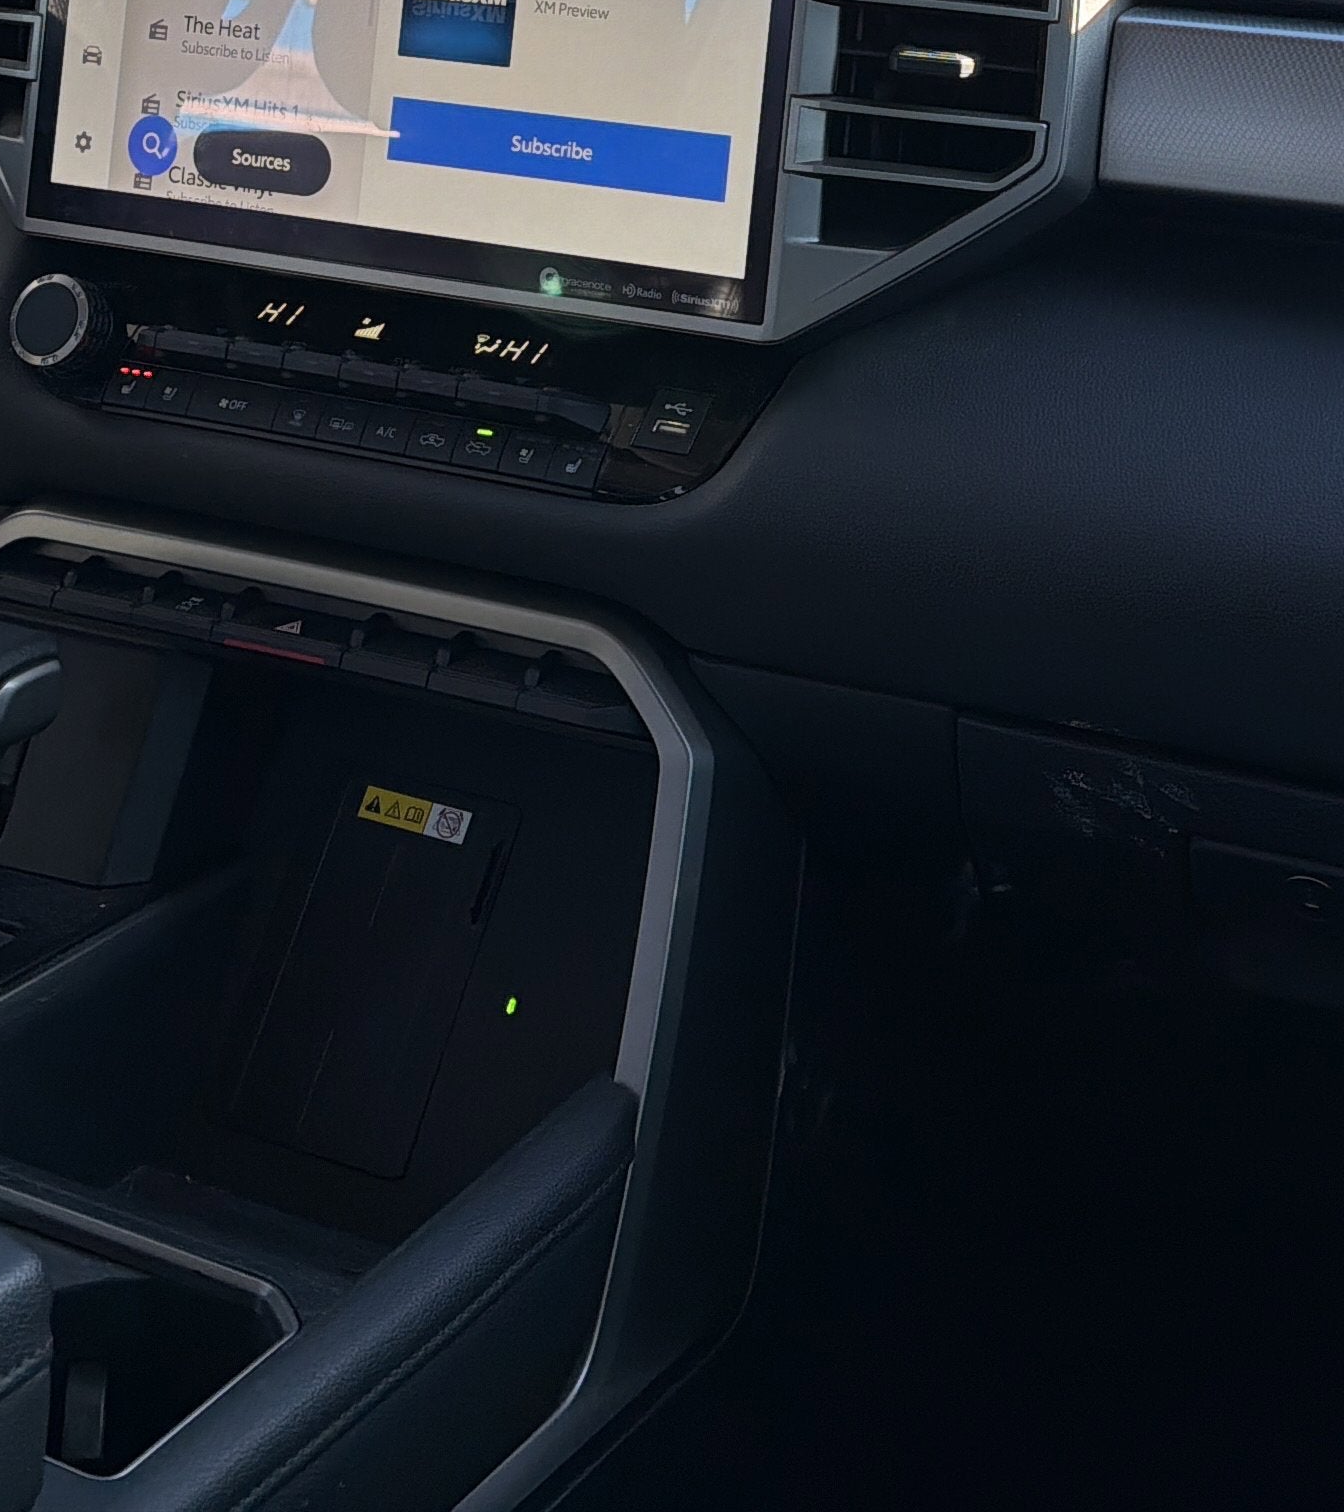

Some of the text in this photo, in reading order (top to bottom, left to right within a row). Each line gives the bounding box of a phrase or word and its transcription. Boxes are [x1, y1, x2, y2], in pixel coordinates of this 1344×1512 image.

[534, 0, 610, 20] XM Preview
[184, 15, 260, 40] The Heat
[181, 40, 238, 59] Subscribe
[241, 46, 253, 61] to
[510, 135, 593, 161] Subscribe
[231, 148, 291, 172] Sources
[636, 288, 663, 301] Radio
[257, 302, 305, 326] HI
[499, 340, 549, 365] HI
[229, 398, 249, 412] OFF
[375, 424, 398, 439] A/C
